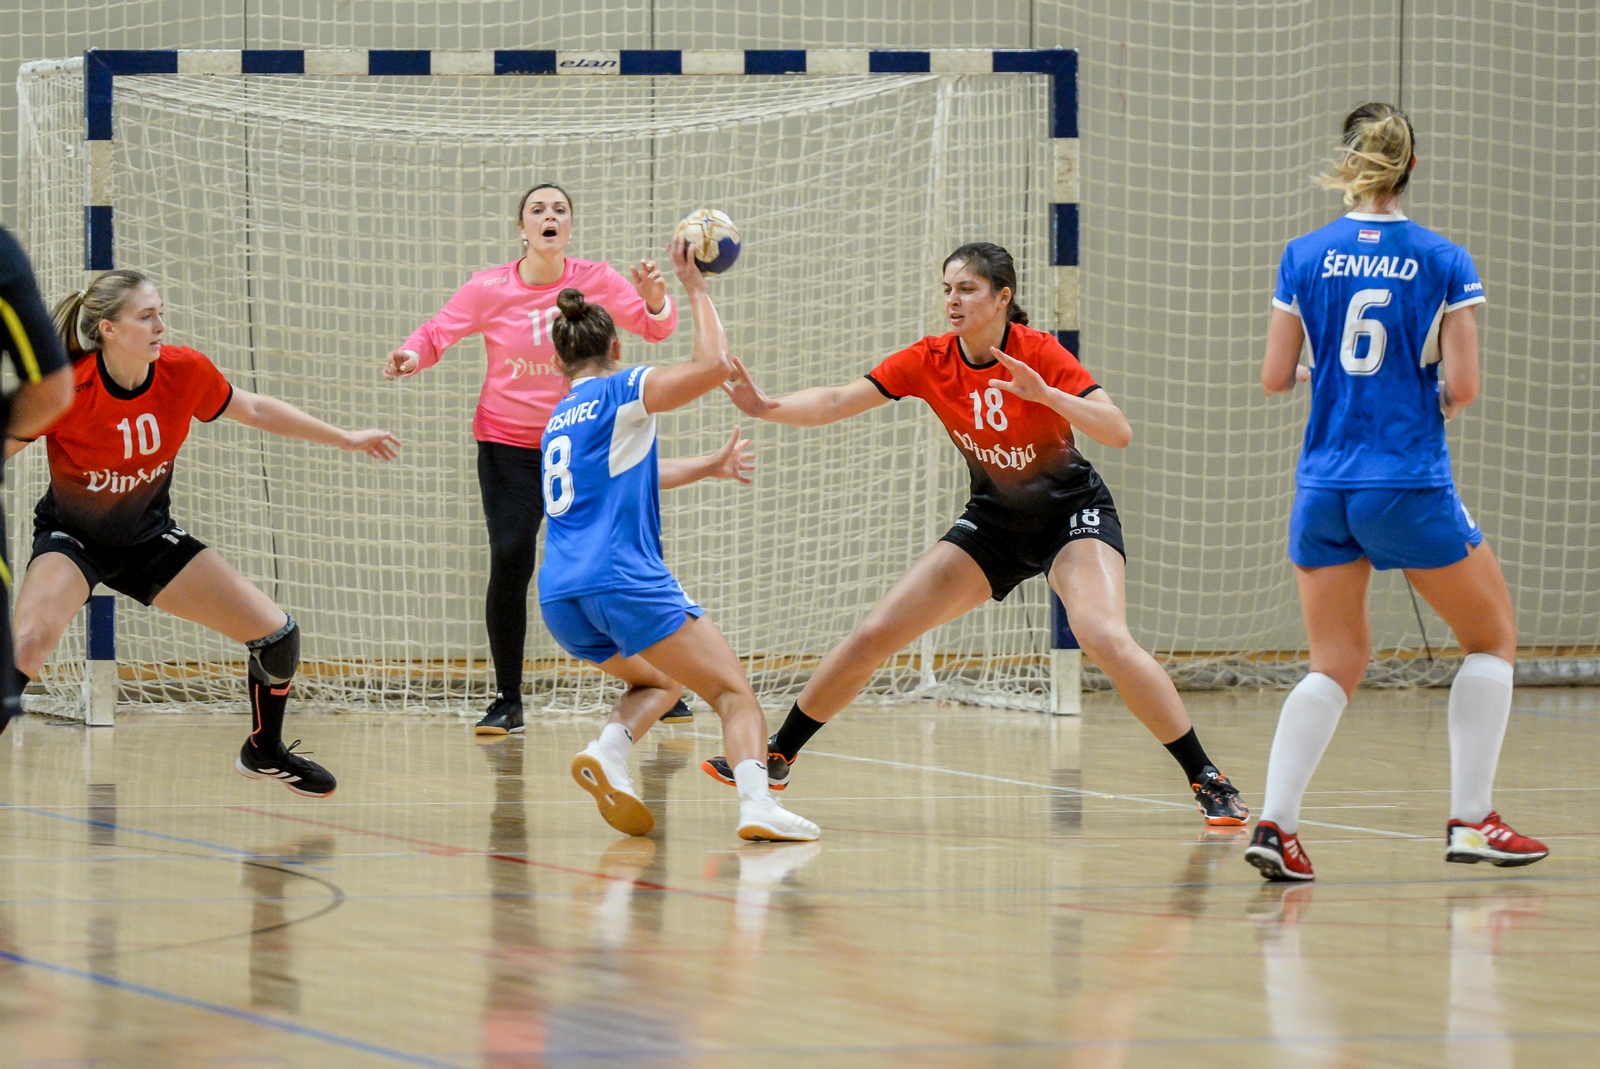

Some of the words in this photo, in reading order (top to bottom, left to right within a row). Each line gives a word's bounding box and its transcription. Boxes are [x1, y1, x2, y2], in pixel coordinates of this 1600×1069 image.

[559, 58, 618, 68] elan
[1321, 248, 1419, 281] ŠENVALD
[1339, 288, 1392, 376] 6
[545, 399, 600, 434] OSAVEC
[968, 387, 1008, 432] 18
[116, 412, 161, 460] 10
[953, 429, 1037, 471] Vindija
[543, 435, 575, 517] 8
[1069, 508, 1100, 528] 18
[1069, 527, 1100, 537] FOTEX
